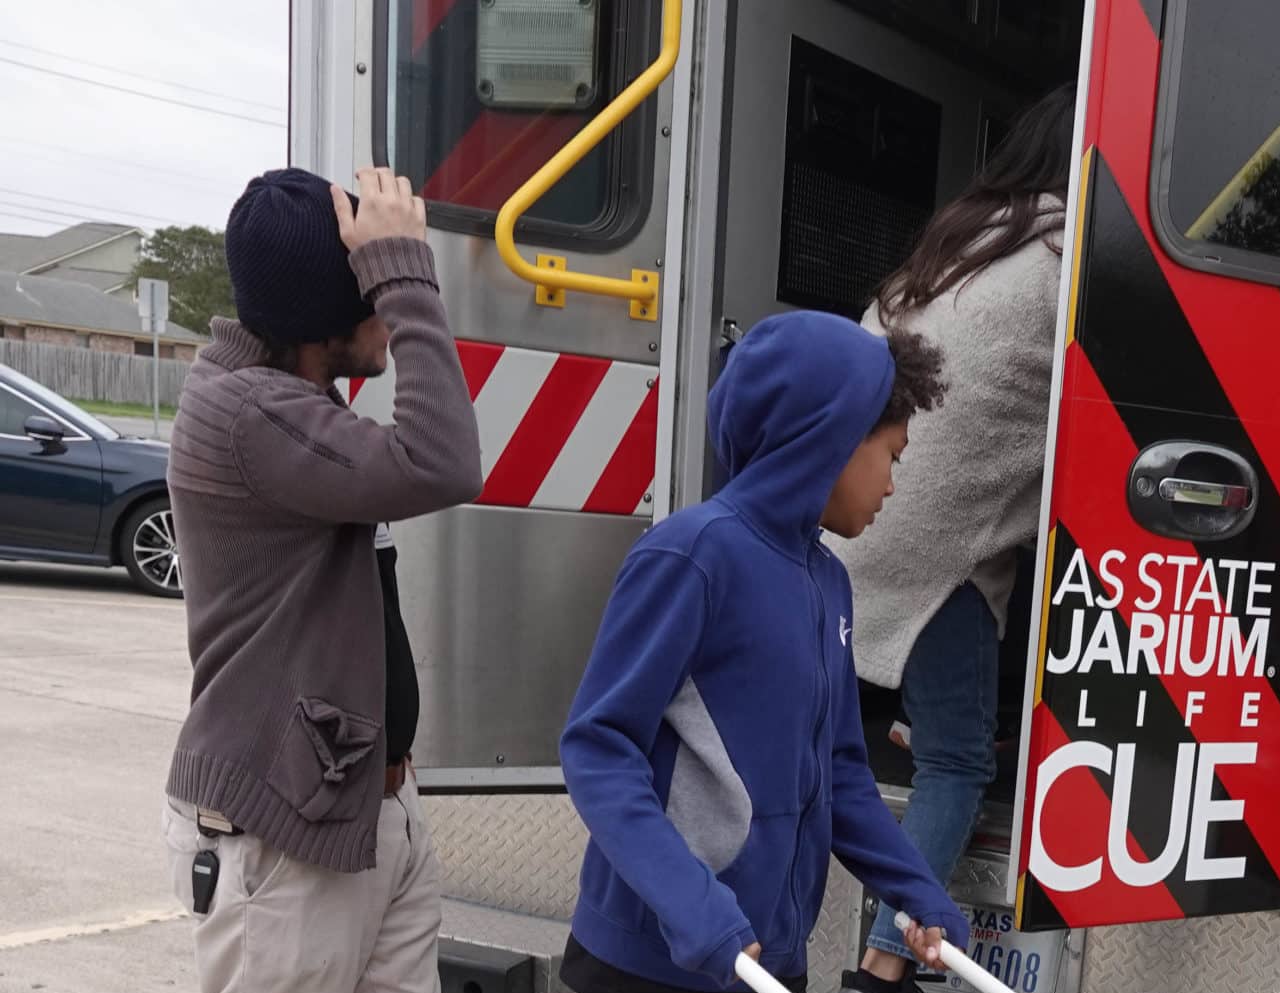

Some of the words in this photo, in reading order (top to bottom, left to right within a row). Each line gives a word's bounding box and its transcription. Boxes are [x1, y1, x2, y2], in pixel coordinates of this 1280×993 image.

[1052, 548, 1126, 609] AS
[1134, 553, 1276, 616] STATE
[1028, 741, 1258, 892] CUE
[963, 907, 1012, 932] XAS
[969, 927, 1001, 941] MPT
